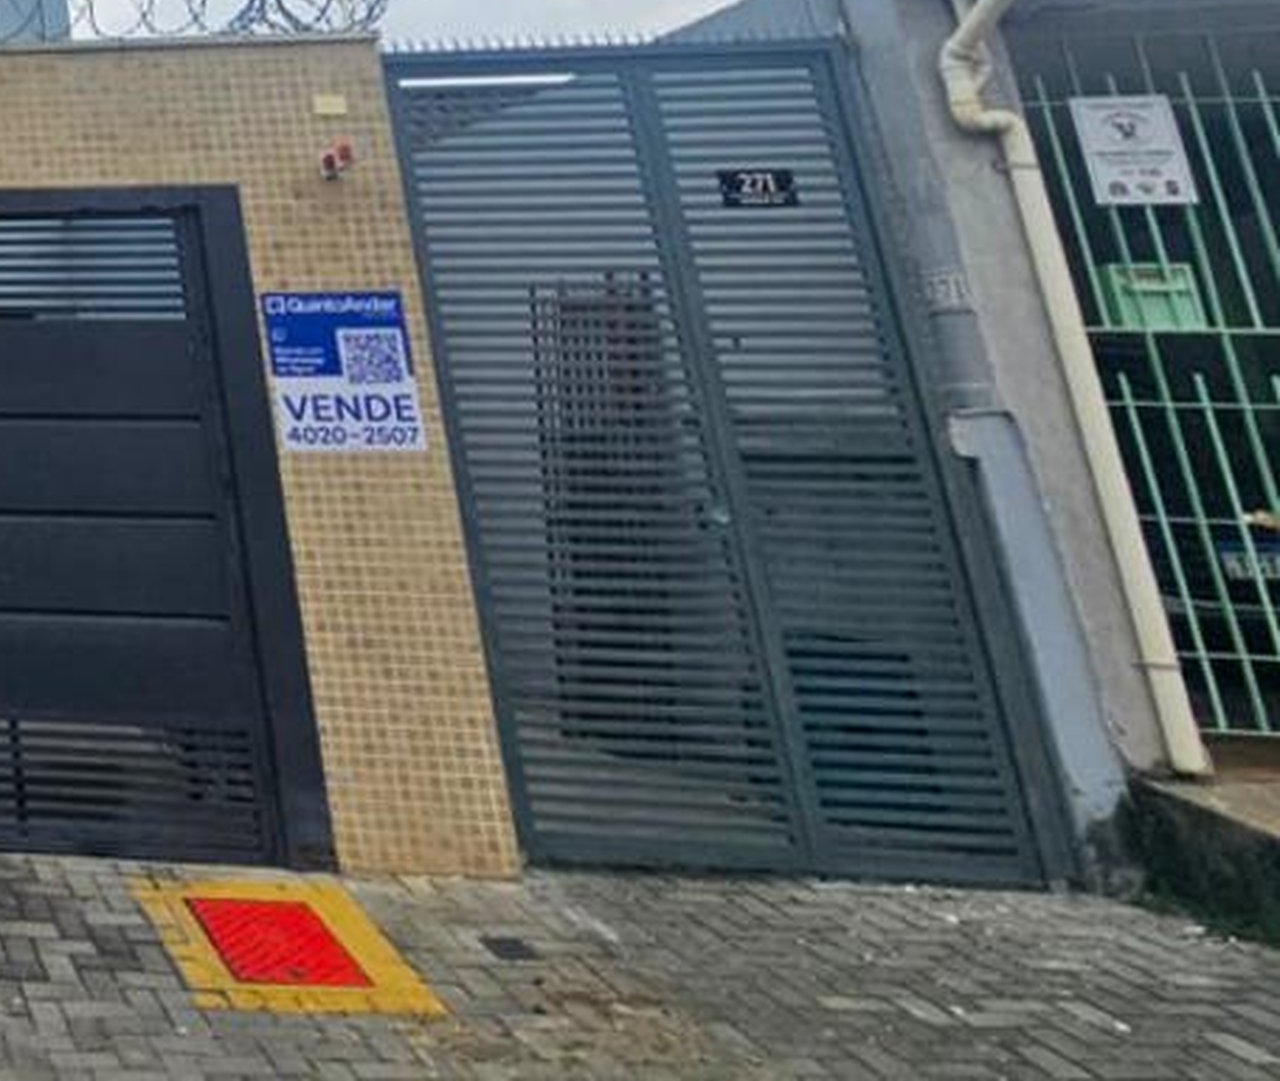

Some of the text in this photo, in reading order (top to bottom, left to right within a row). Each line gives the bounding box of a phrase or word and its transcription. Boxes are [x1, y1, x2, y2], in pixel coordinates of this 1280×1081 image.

[737, 171, 776, 194] 271
[286, 295, 397, 315] QuintoAndar
[281, 393, 418, 422] VENDE
[286, 424, 419, 445] 4020-2507
